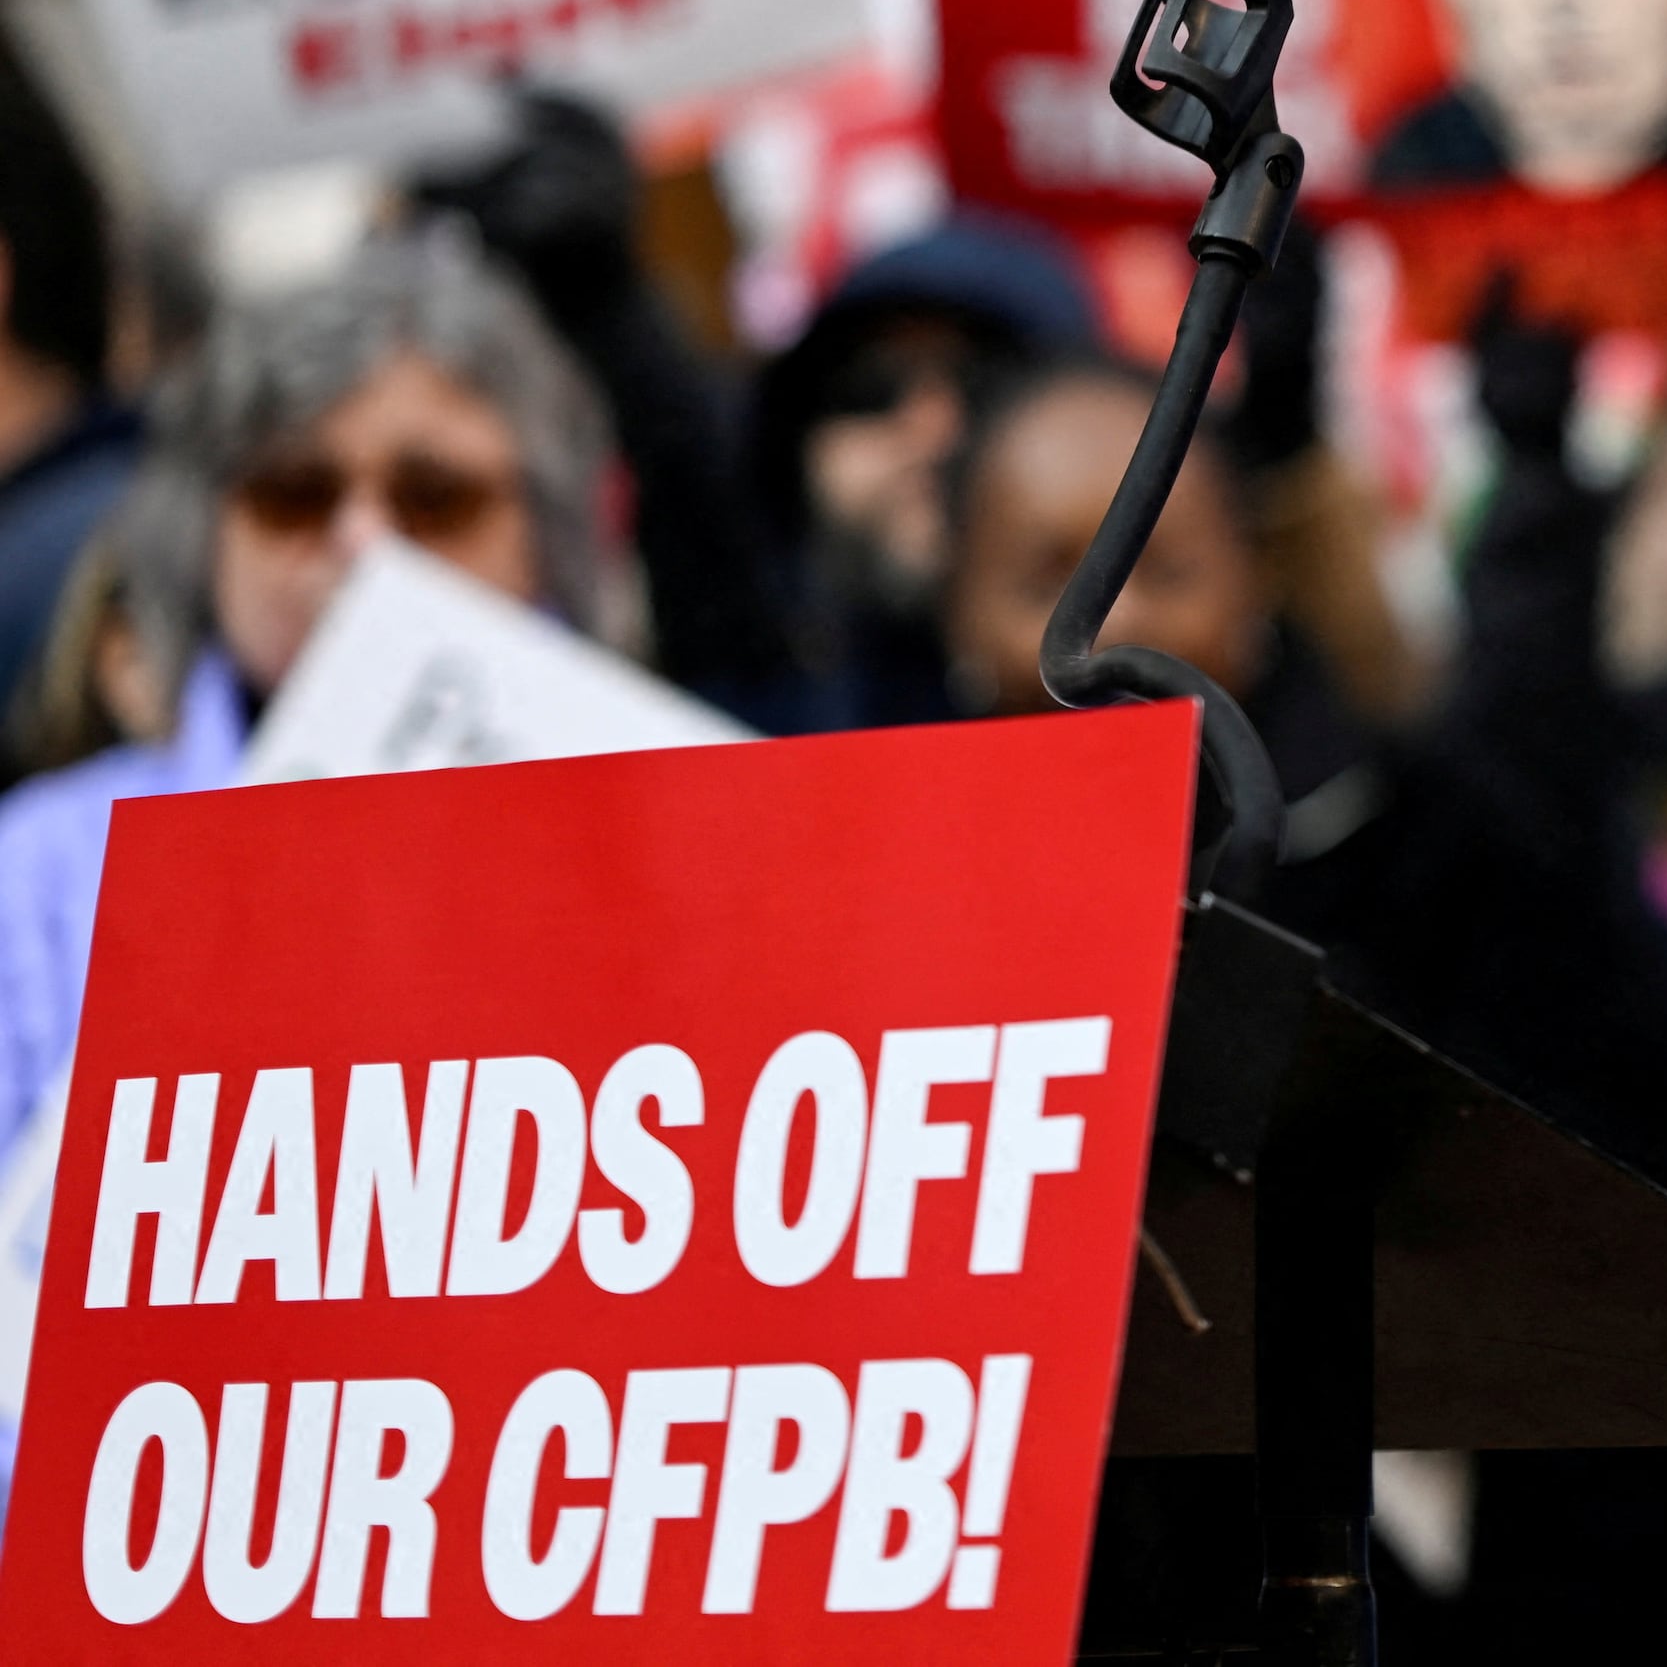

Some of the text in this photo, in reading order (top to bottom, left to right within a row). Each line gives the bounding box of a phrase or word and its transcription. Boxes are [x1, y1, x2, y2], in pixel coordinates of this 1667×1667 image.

[84, 1014, 1113, 1310] HANDS OFF
[82, 1353, 1033, 1626] OUR CFPB!
